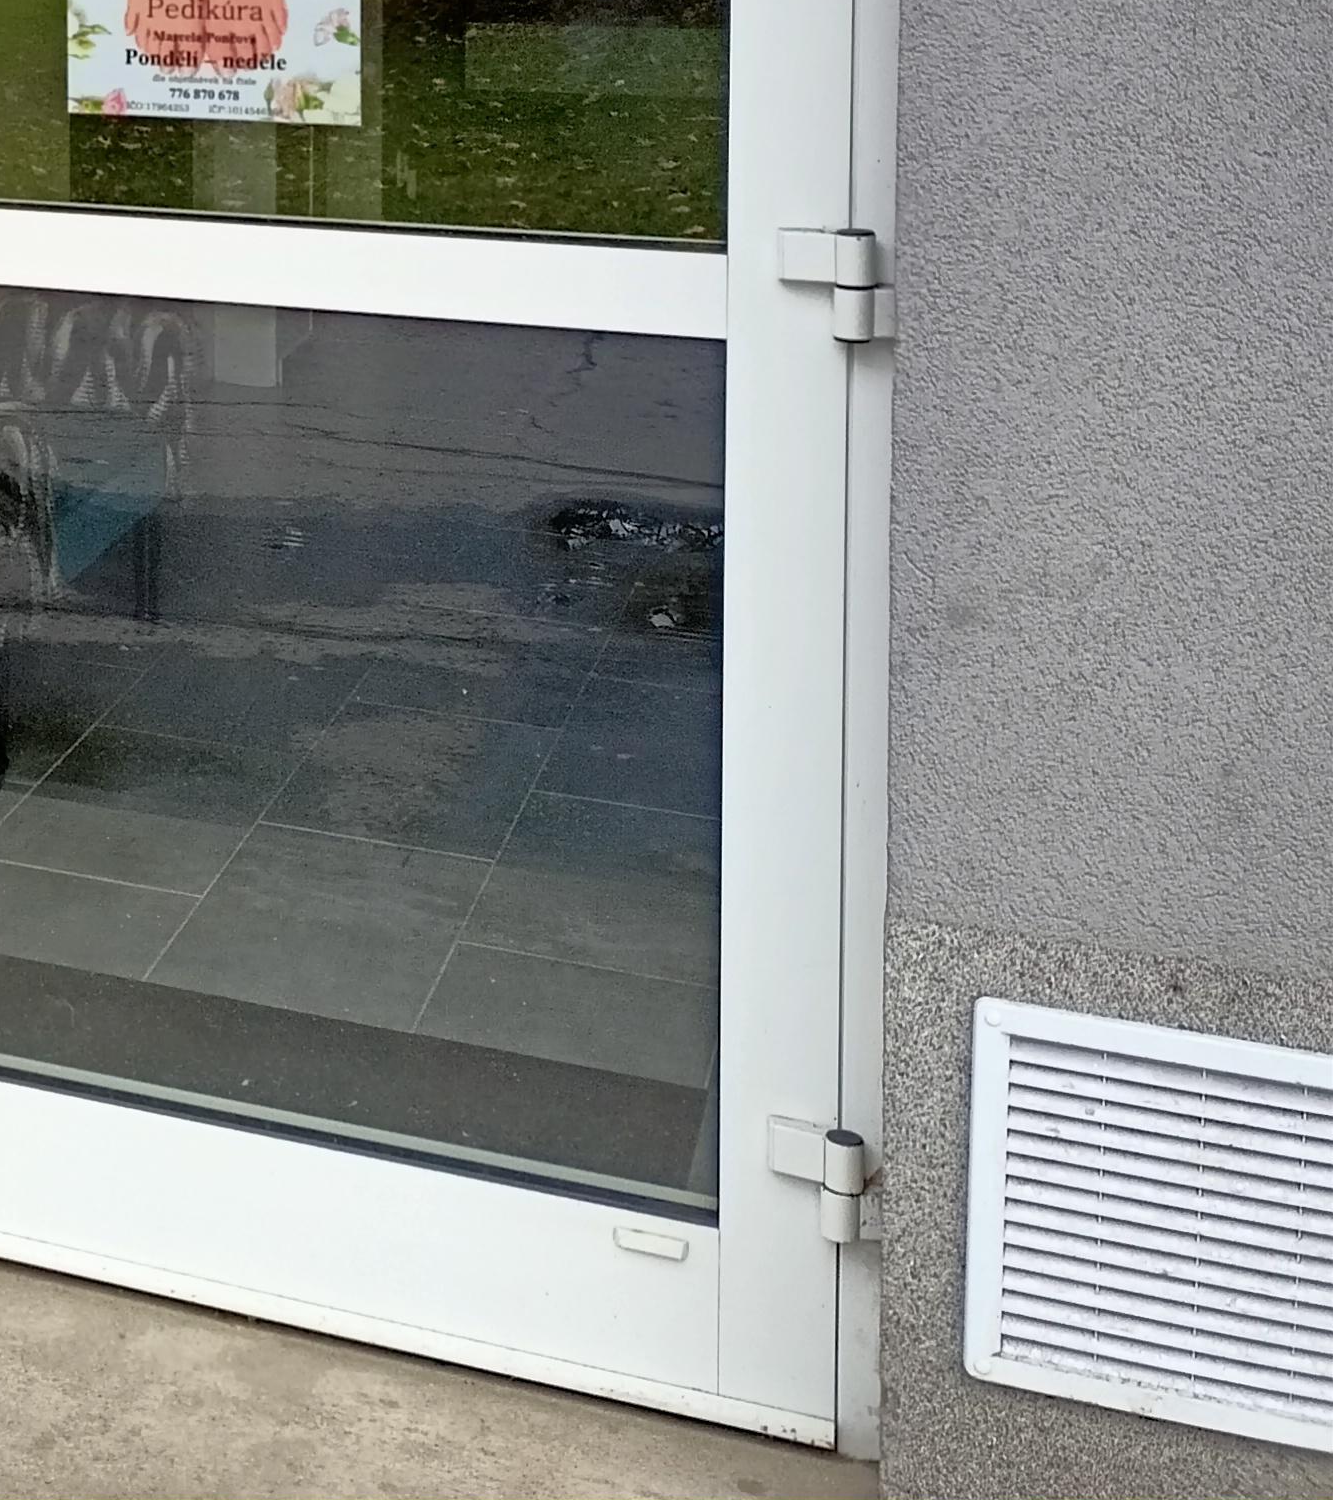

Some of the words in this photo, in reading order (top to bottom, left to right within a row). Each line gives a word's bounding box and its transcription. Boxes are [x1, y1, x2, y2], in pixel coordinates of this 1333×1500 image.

[125, 48, 199, 68] Pondělí
[222, 52, 288, 71] neděle
[169, 88, 191, 100] 776
[193, 88, 215, 101] 870
[218, 89, 240, 101] 678
